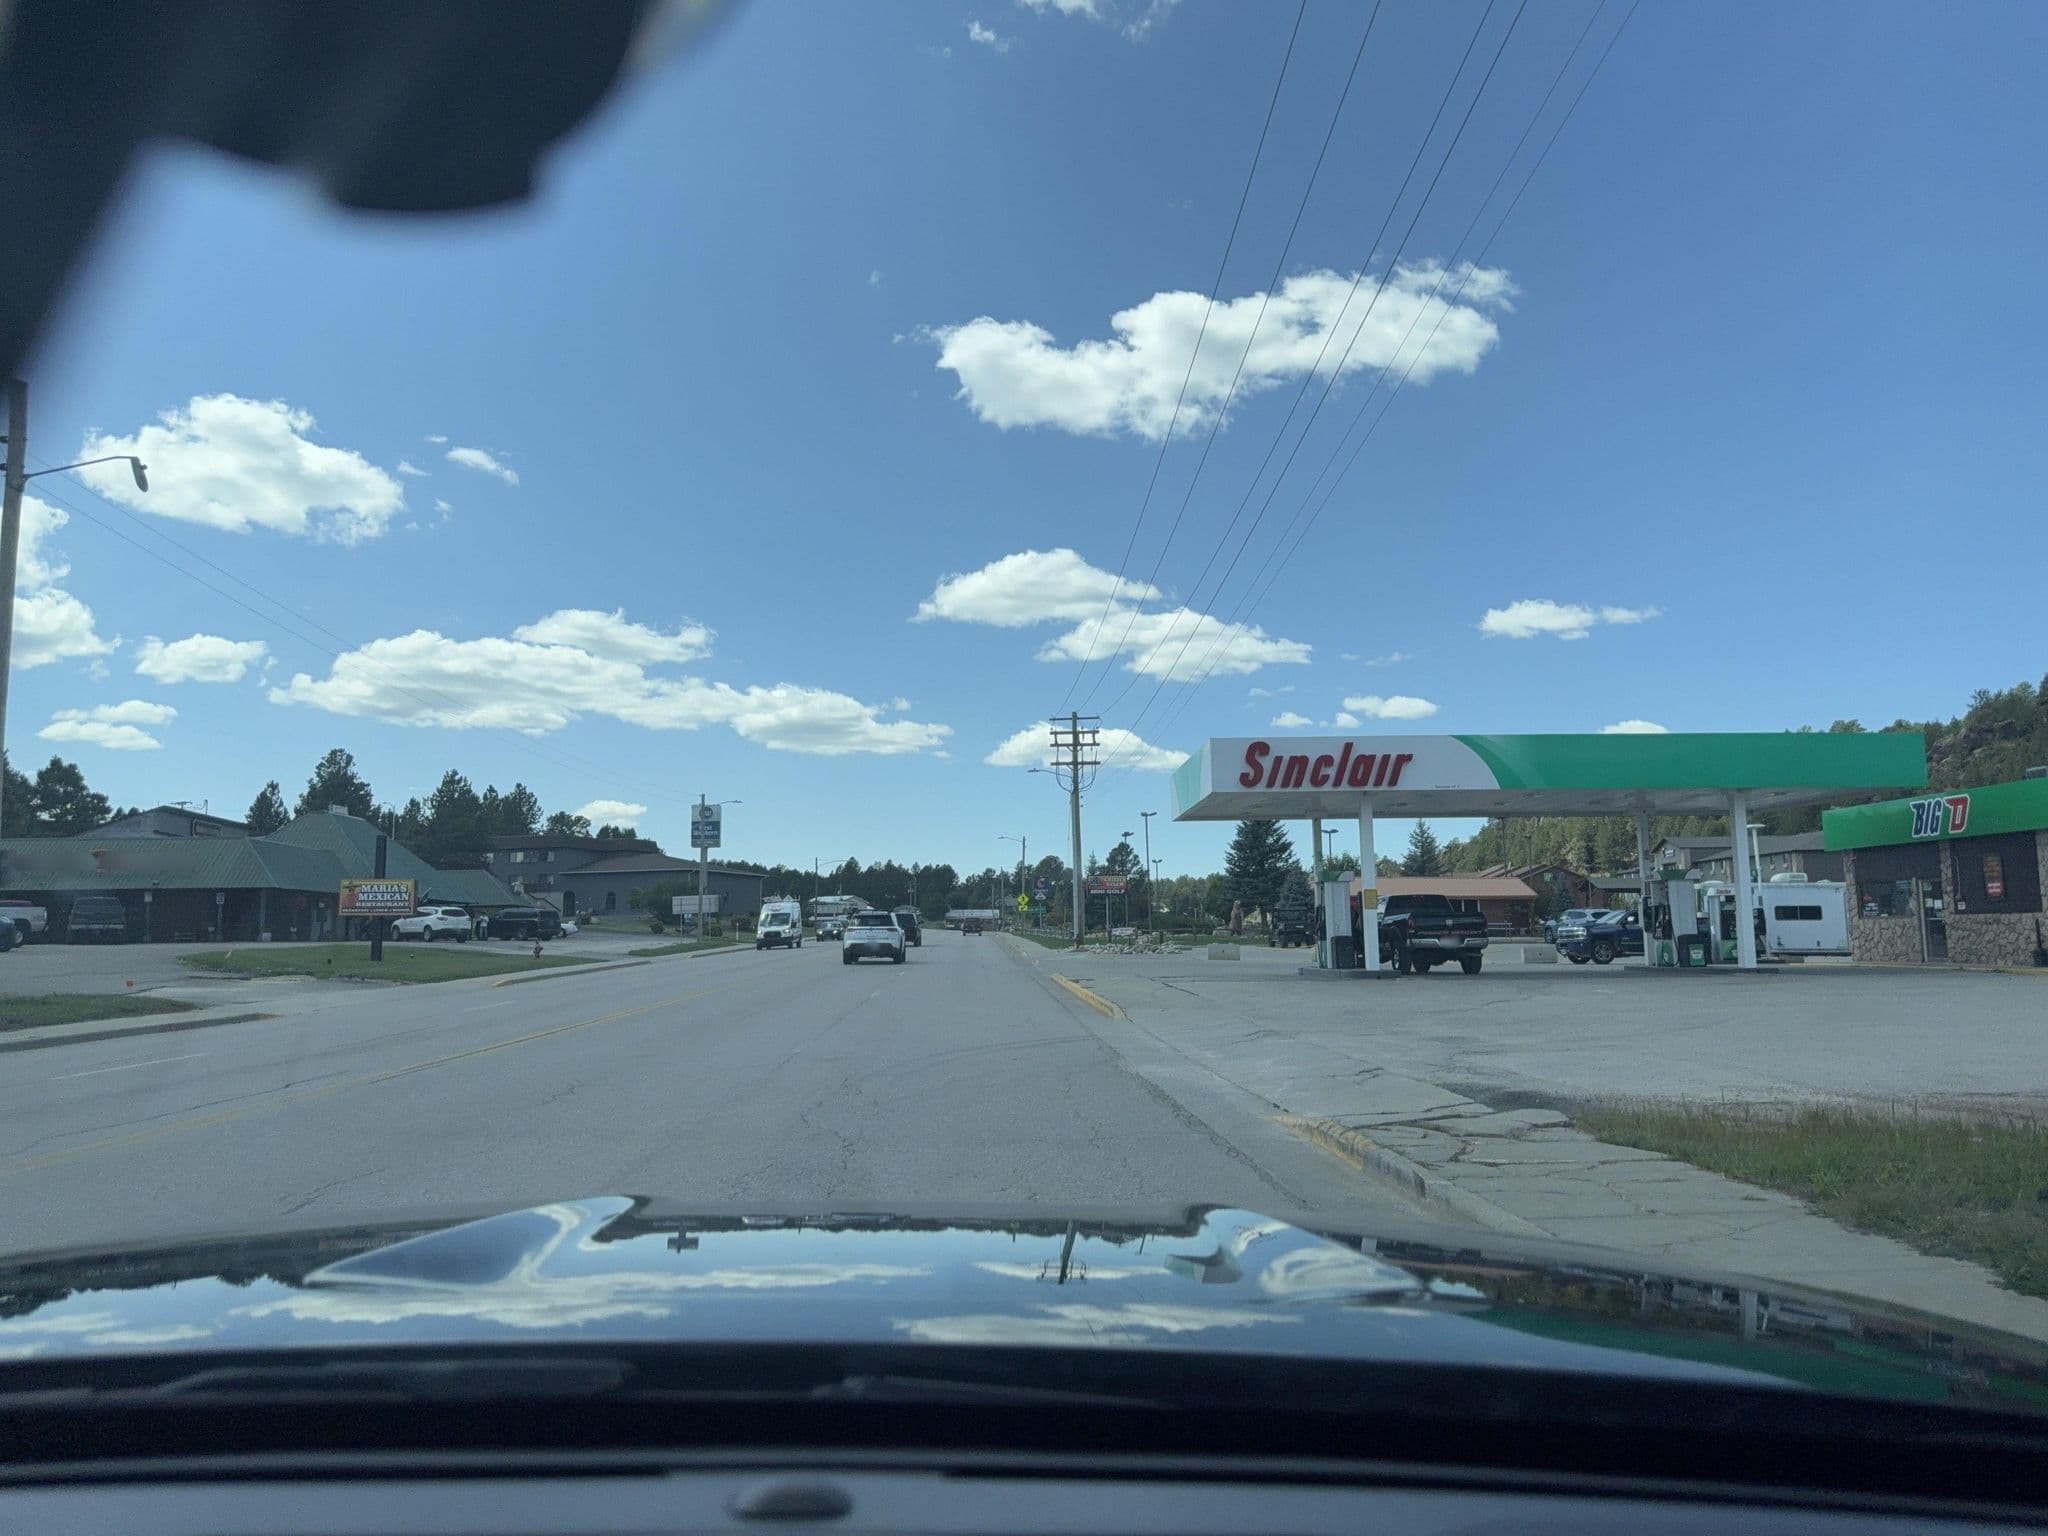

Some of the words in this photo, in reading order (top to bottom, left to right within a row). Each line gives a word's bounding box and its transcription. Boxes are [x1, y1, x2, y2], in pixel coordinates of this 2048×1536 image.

[1239, 741, 1413, 788] Sinclair
[1910, 798, 1943, 837] BIG
[1943, 794, 1971, 833] D
[358, 892, 409, 901] MEXICAN
[361, 883, 407, 893] MARIA'S
